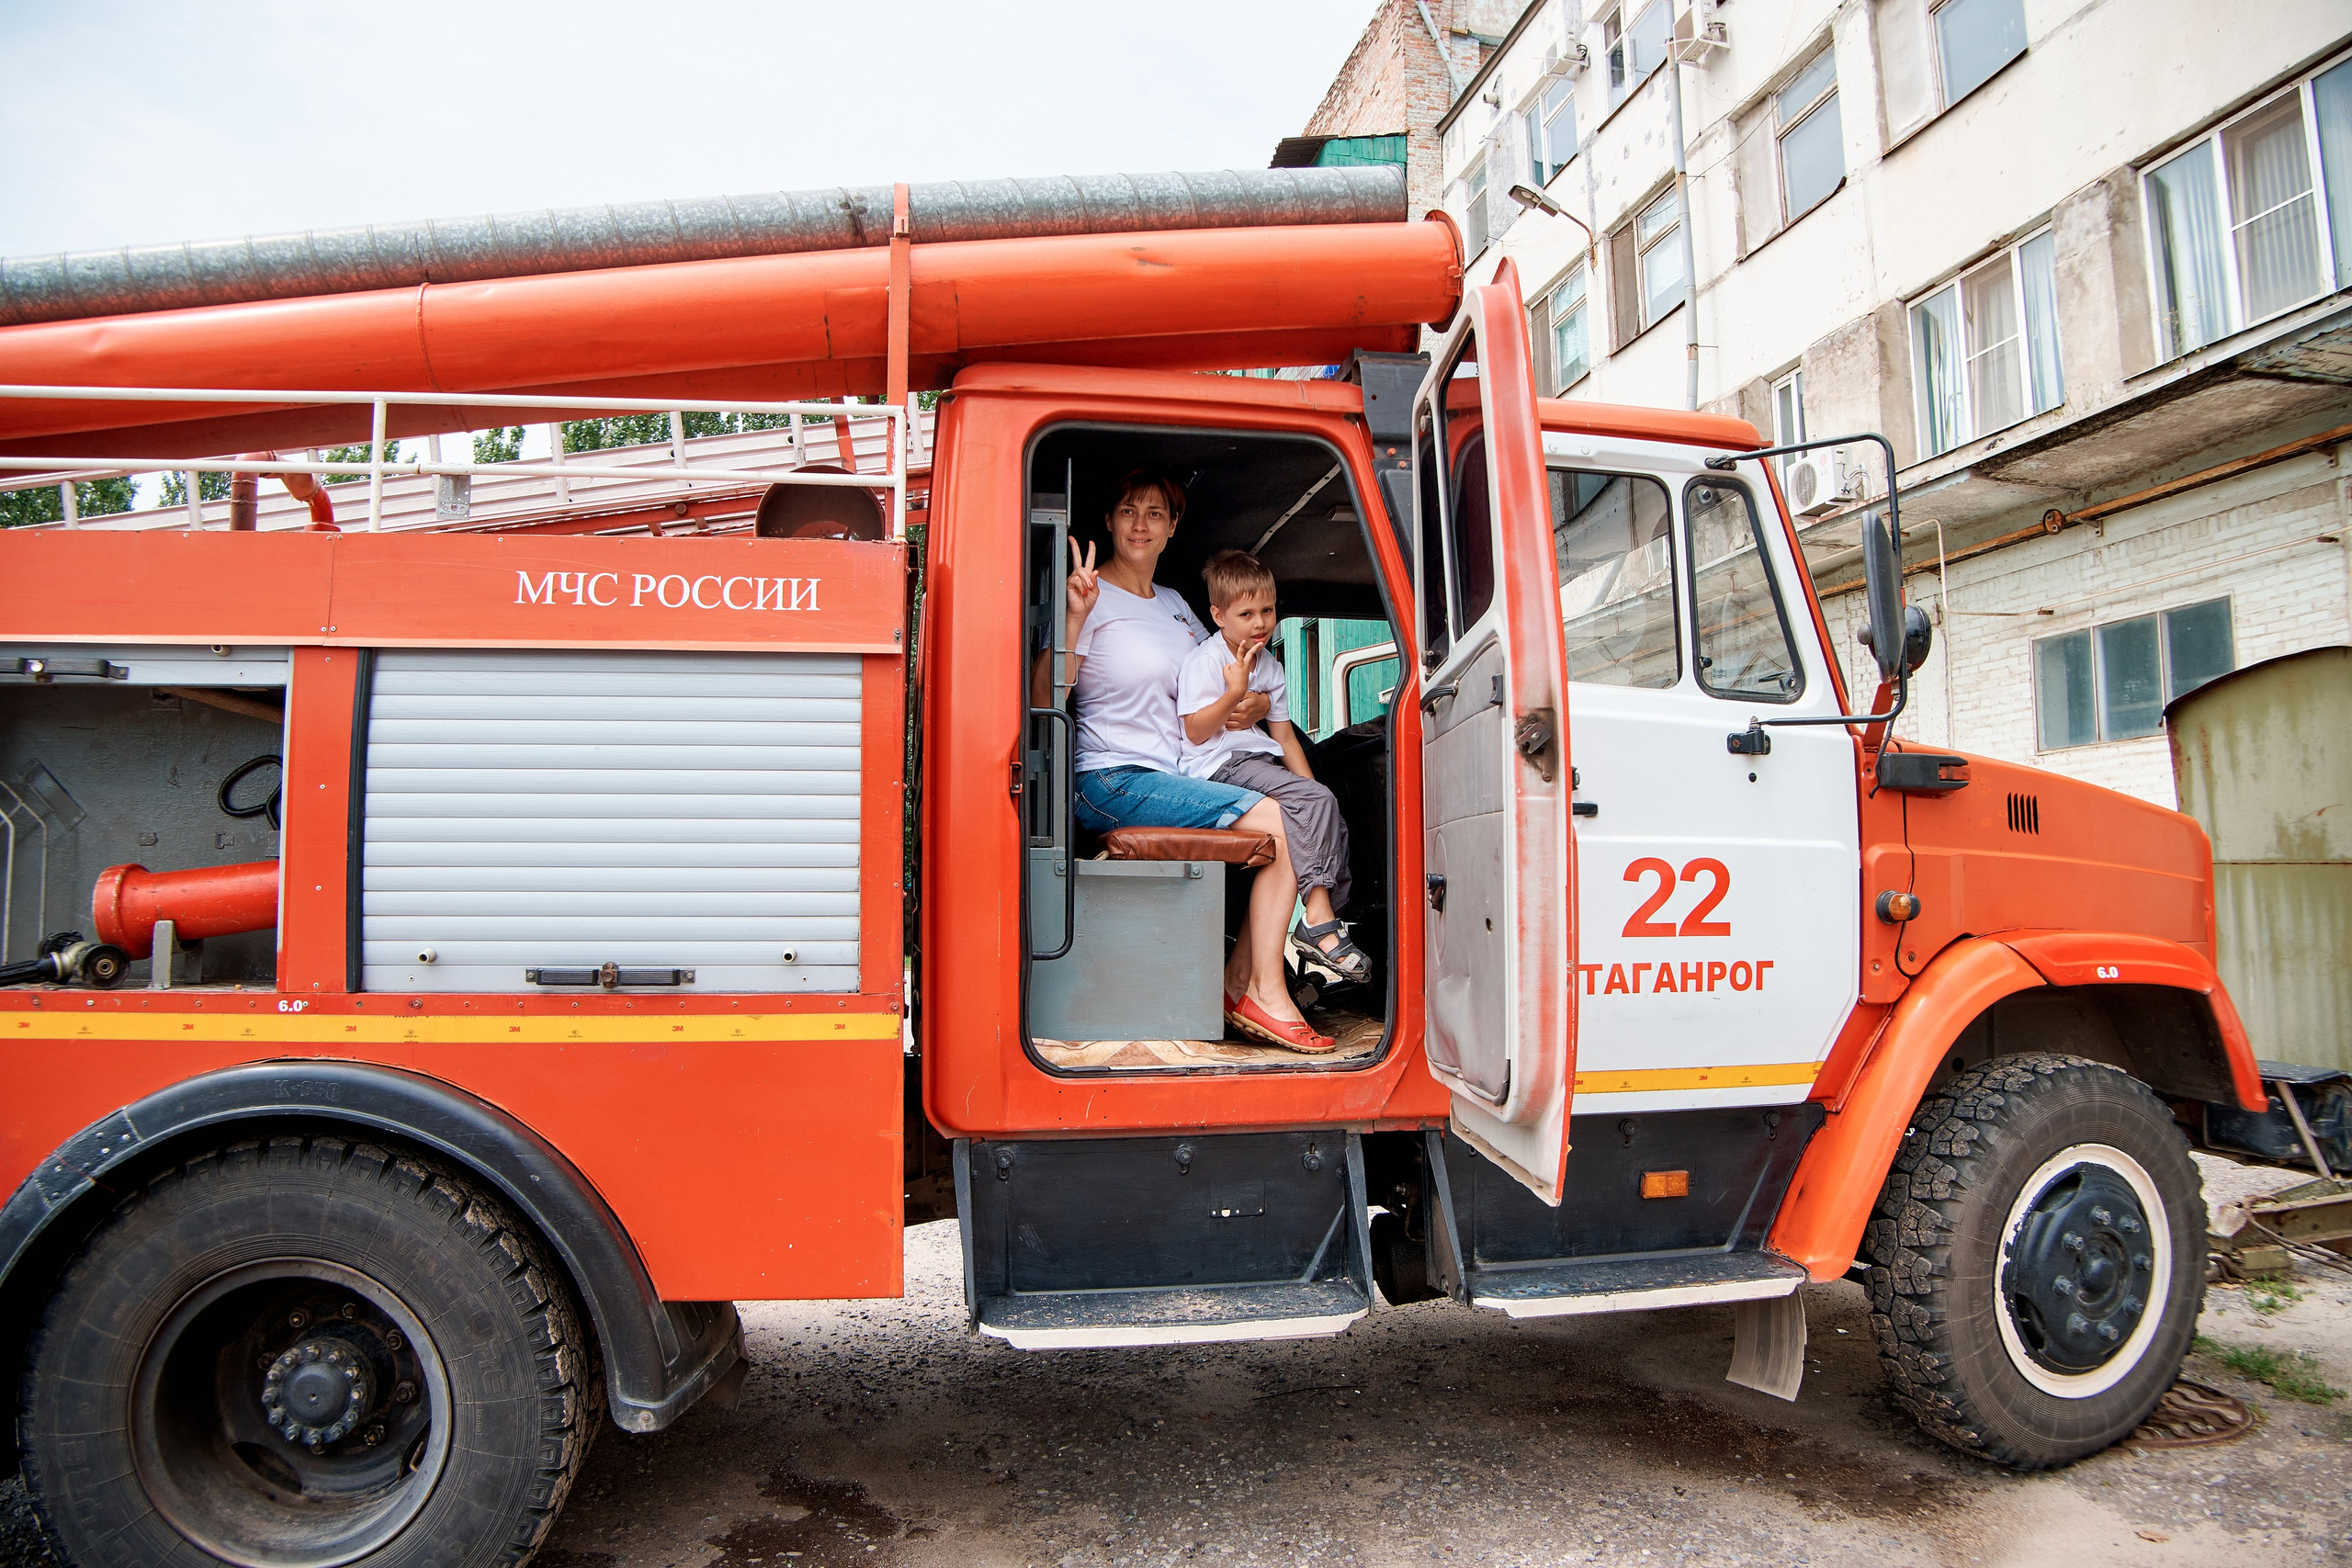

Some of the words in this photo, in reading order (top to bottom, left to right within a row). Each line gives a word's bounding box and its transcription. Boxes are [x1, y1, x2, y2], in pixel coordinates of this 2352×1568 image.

[514, 570, 618, 606] МЧС
[629, 573, 821, 611] РОССИИ
[1622, 857, 1731, 937] 22
[1577, 960, 1774, 995] ТАГАНРОГ
[2097, 966, 2119, 979] 6.0
[277, 999, 303, 1012] 6.0
